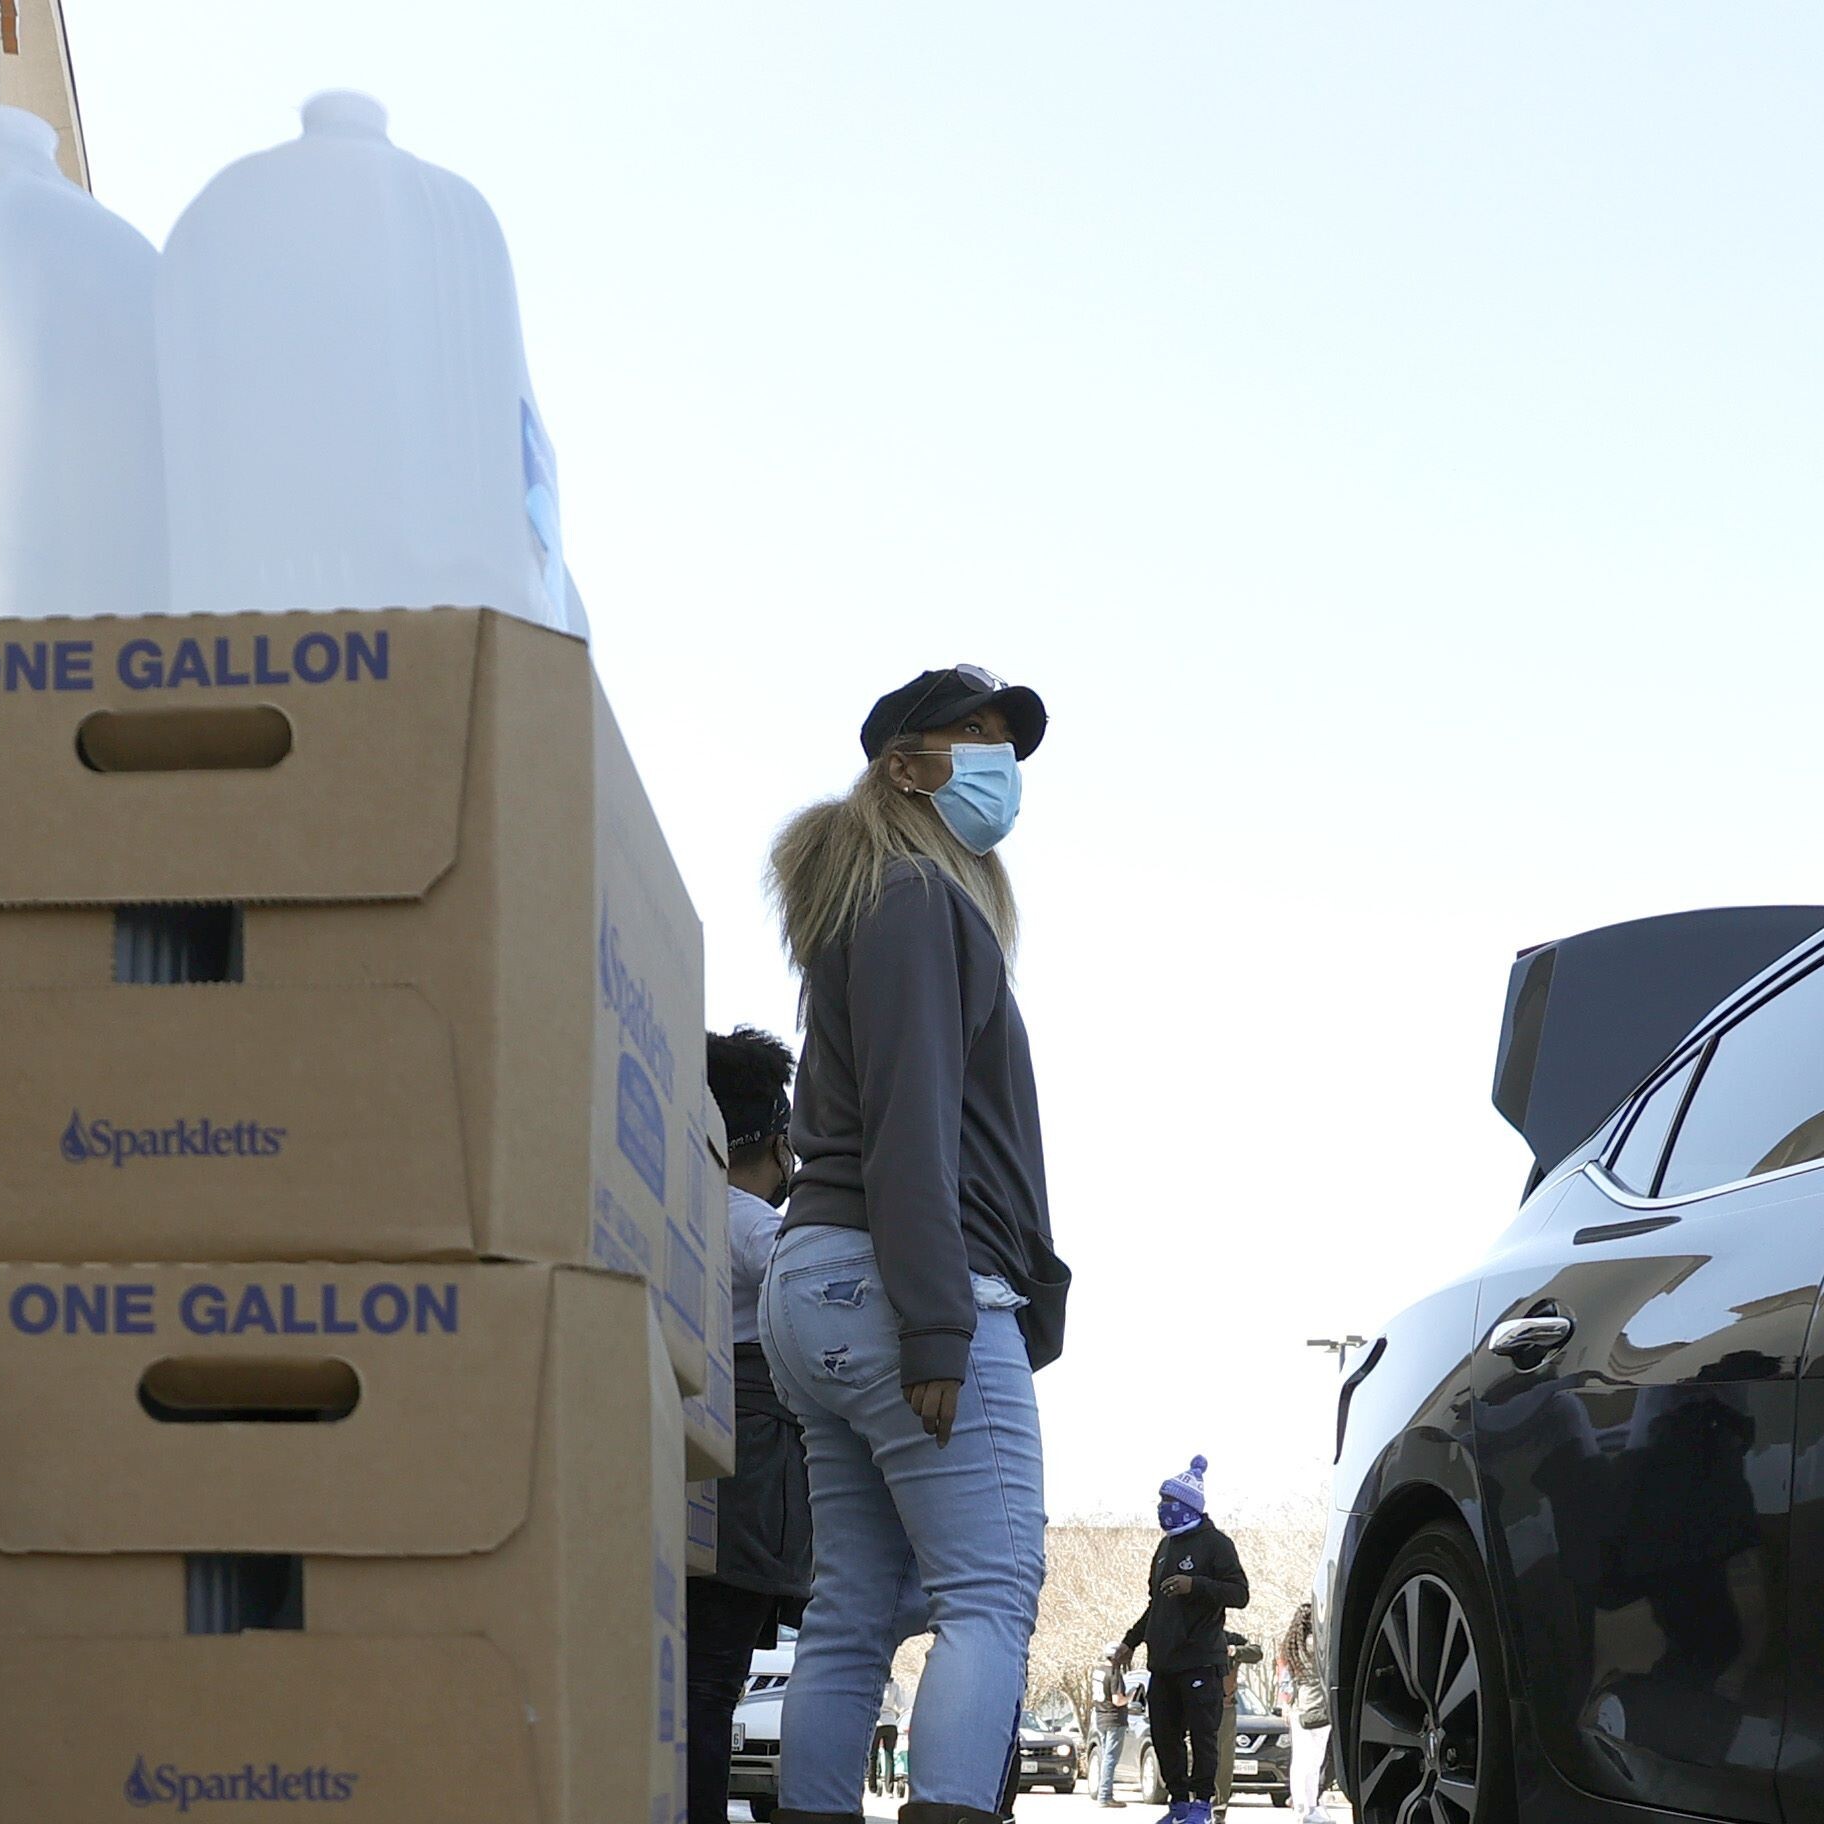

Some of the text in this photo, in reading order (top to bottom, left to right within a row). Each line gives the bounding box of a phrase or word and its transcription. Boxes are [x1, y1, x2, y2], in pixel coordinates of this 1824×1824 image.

[116, 631, 390, 689] GALLON
[89, 1117, 282, 1167] Sparkletts
[9, 1283, 459, 1336] ONE GALLON
[154, 1764, 354, 1813] Sparkletts
